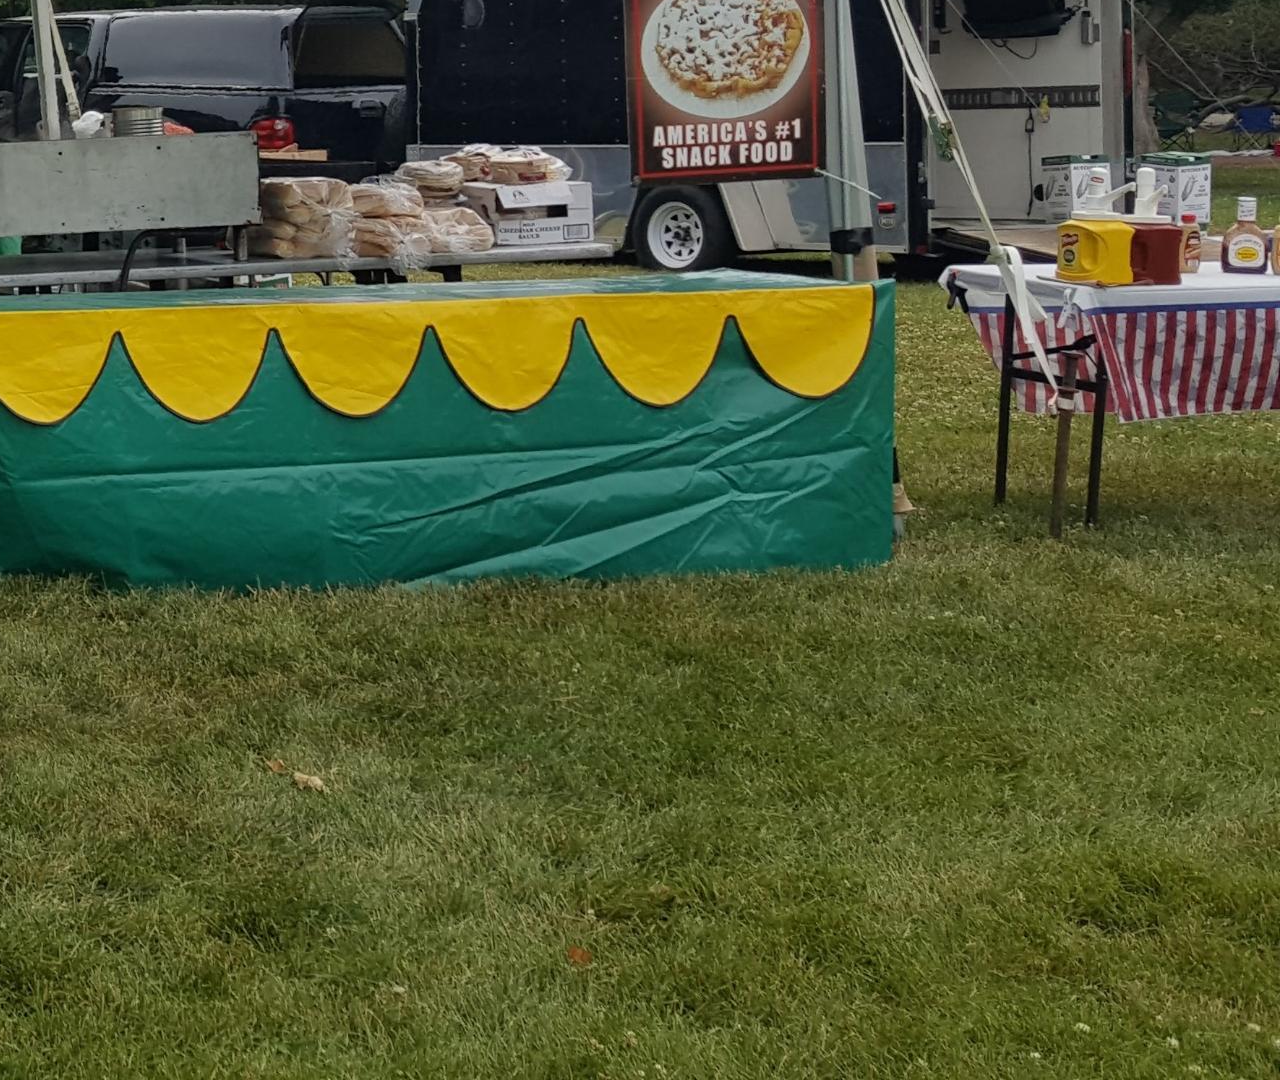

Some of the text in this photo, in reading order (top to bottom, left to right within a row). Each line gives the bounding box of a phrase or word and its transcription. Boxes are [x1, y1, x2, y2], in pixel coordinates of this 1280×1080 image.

[653, 118, 801, 147] AMERICA'S #1
[661, 141, 793, 169] SNACK FOOD
